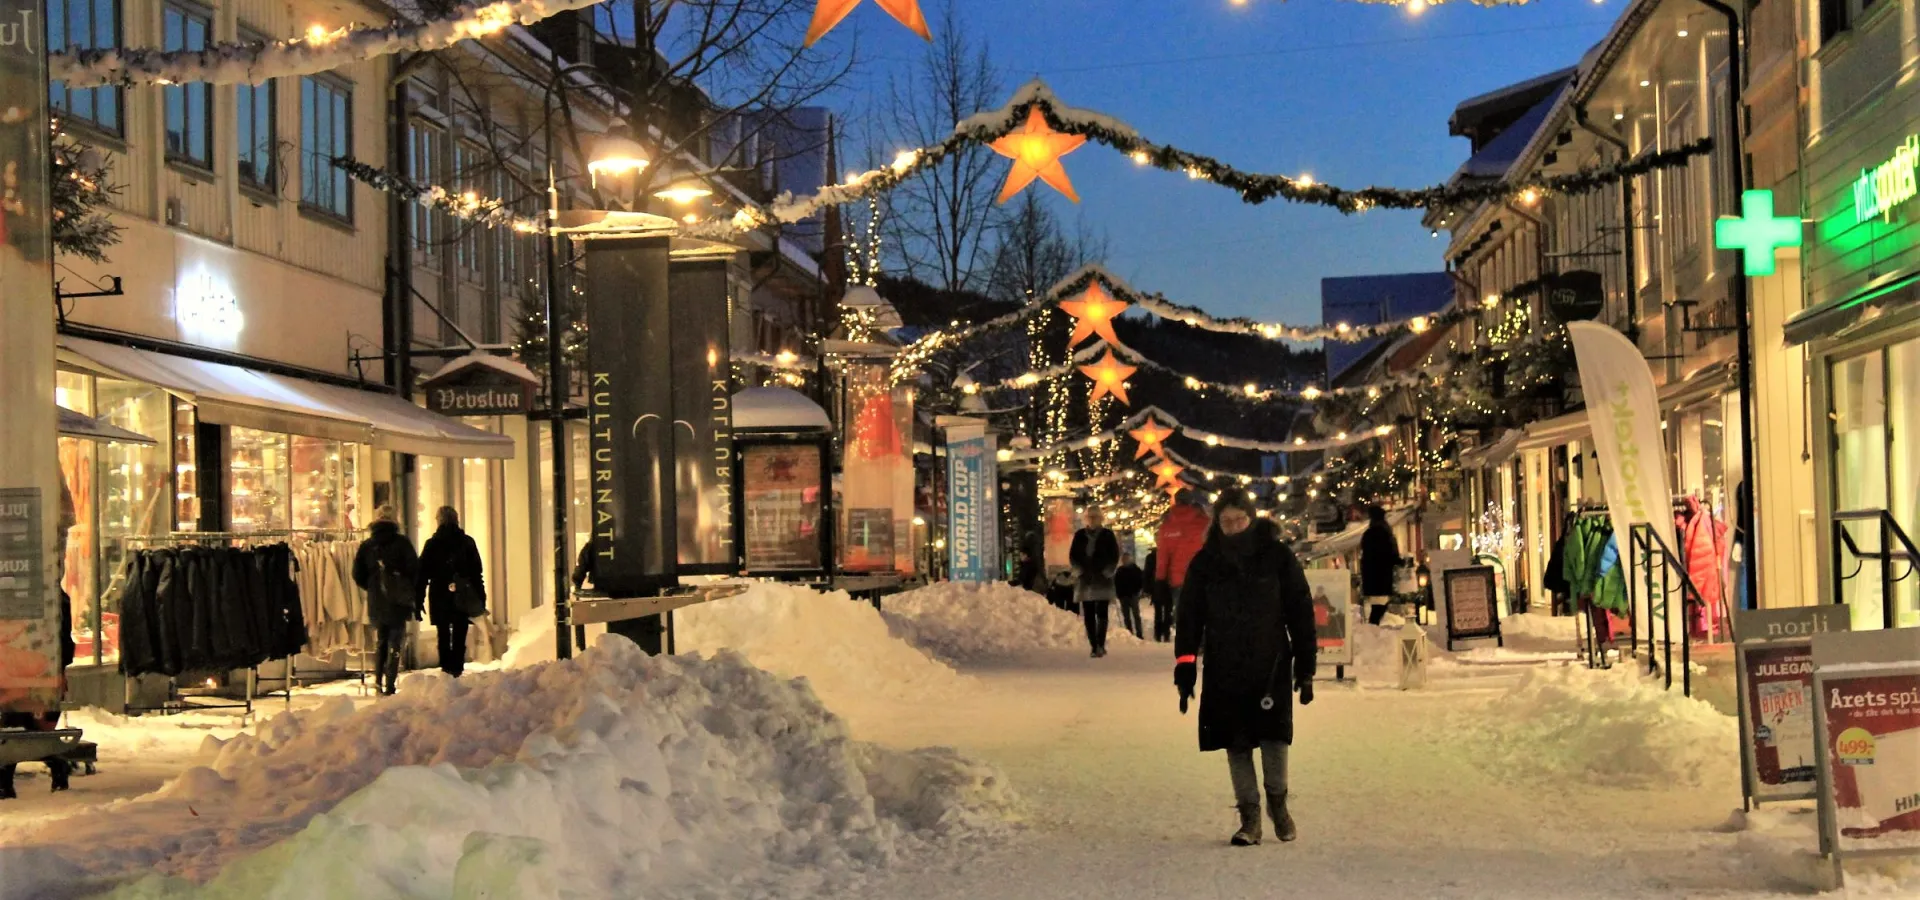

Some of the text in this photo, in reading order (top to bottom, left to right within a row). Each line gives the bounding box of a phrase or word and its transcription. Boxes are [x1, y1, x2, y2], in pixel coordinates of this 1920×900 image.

[593, 372, 614, 561] KULTURNATT
[955, 459, 969, 498] CUP
[955, 501, 969, 569] WORLD
[969, 471, 979, 557] LILLEHAMMER
[1768, 613, 1829, 635] norli
[1831, 687, 1887, 709] Årets
